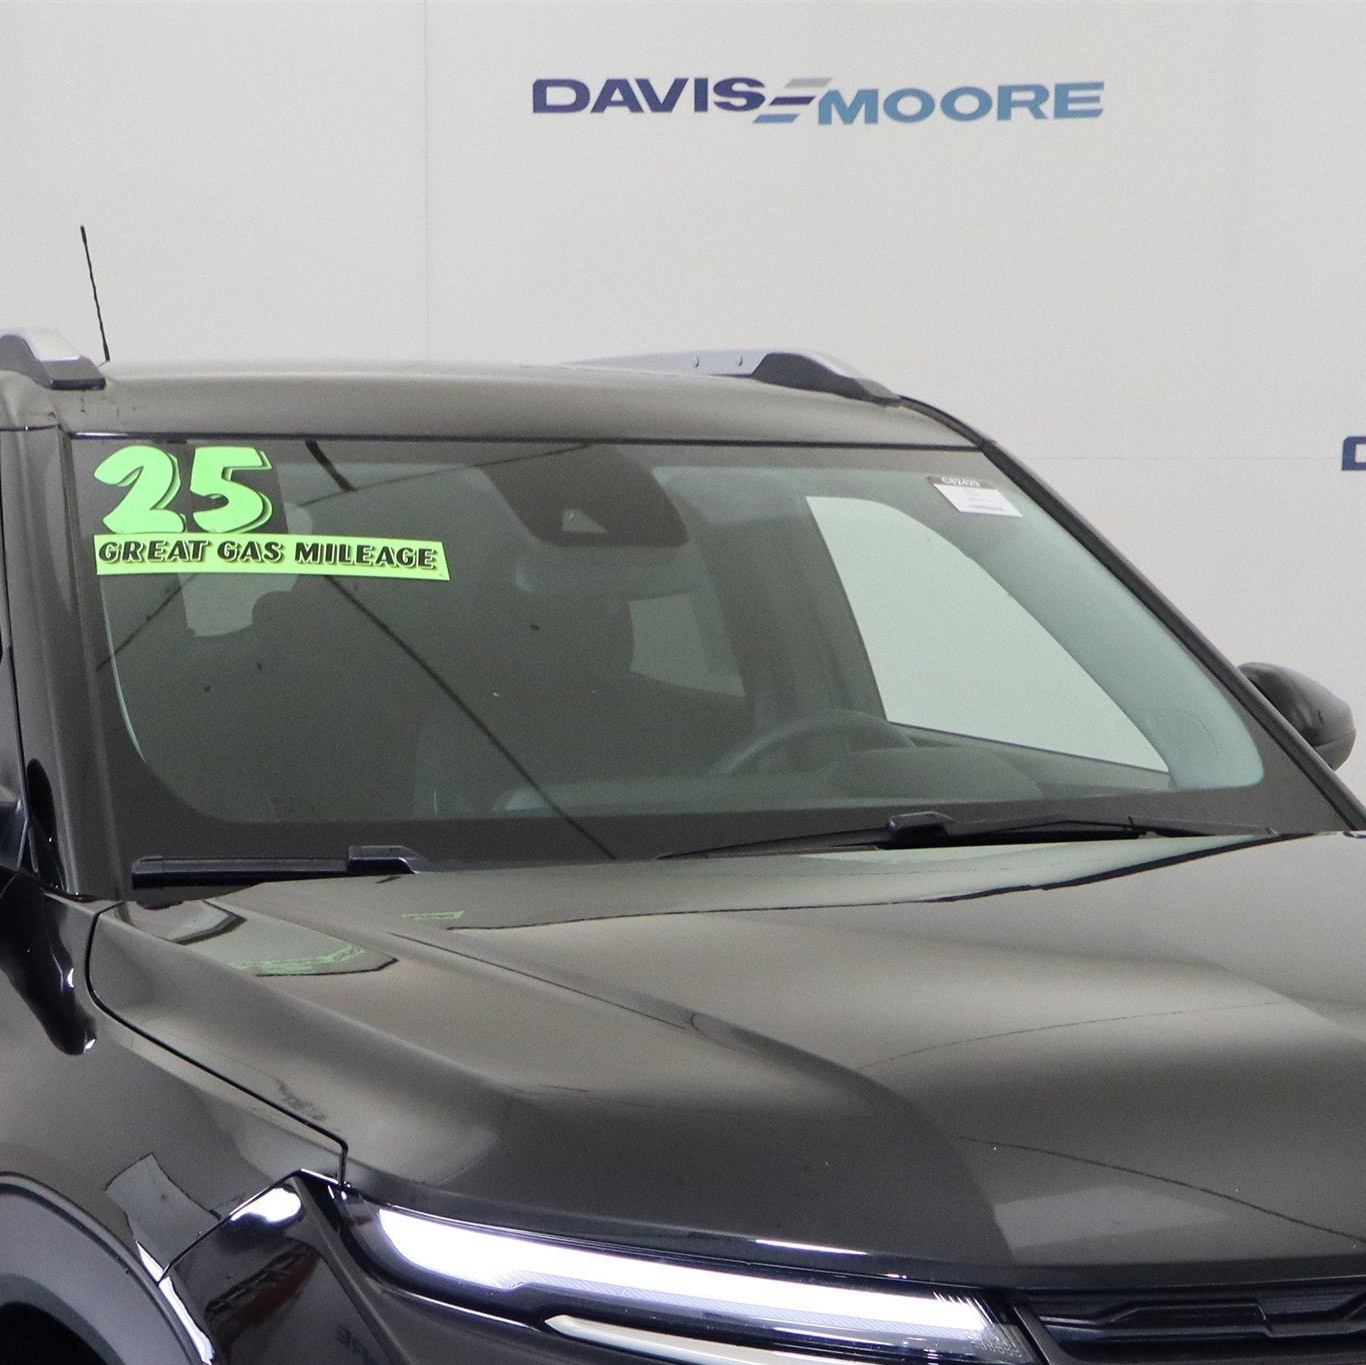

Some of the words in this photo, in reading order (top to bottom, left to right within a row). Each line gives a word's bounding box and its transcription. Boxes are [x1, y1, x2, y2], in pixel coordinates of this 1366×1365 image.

[532, 76, 764, 114] DAVIS
[818, 81, 1105, 126] MOORE
[94, 445, 273, 534] 25
[99, 539, 211, 564] GREAT
[217, 540, 285, 564] GAS
[294, 541, 439, 570] MILEAGE
